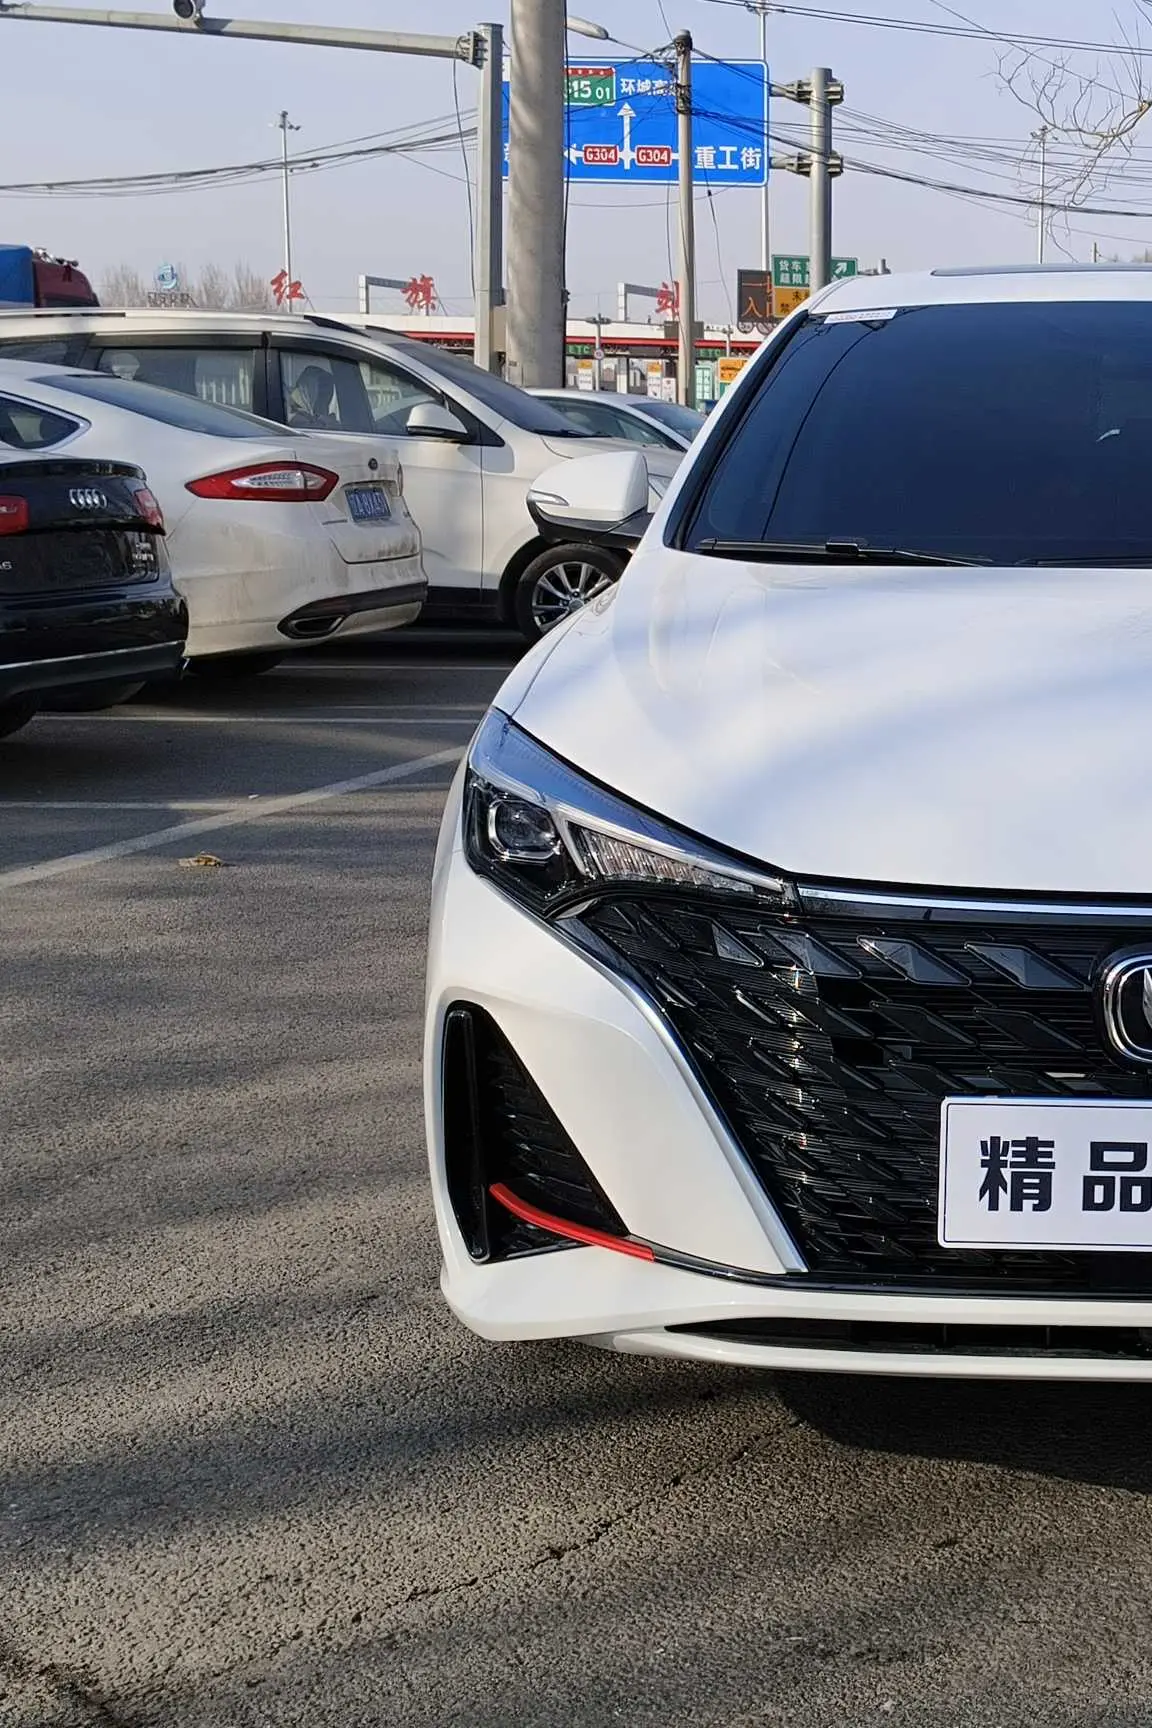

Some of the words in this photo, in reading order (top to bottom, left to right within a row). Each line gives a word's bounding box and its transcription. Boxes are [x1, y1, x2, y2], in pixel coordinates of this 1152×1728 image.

[586, 148, 616, 161] G304
[638, 149, 669, 162] G304
[694, 146, 763, 170] 重工街
[568, 345, 590, 354] ETC
